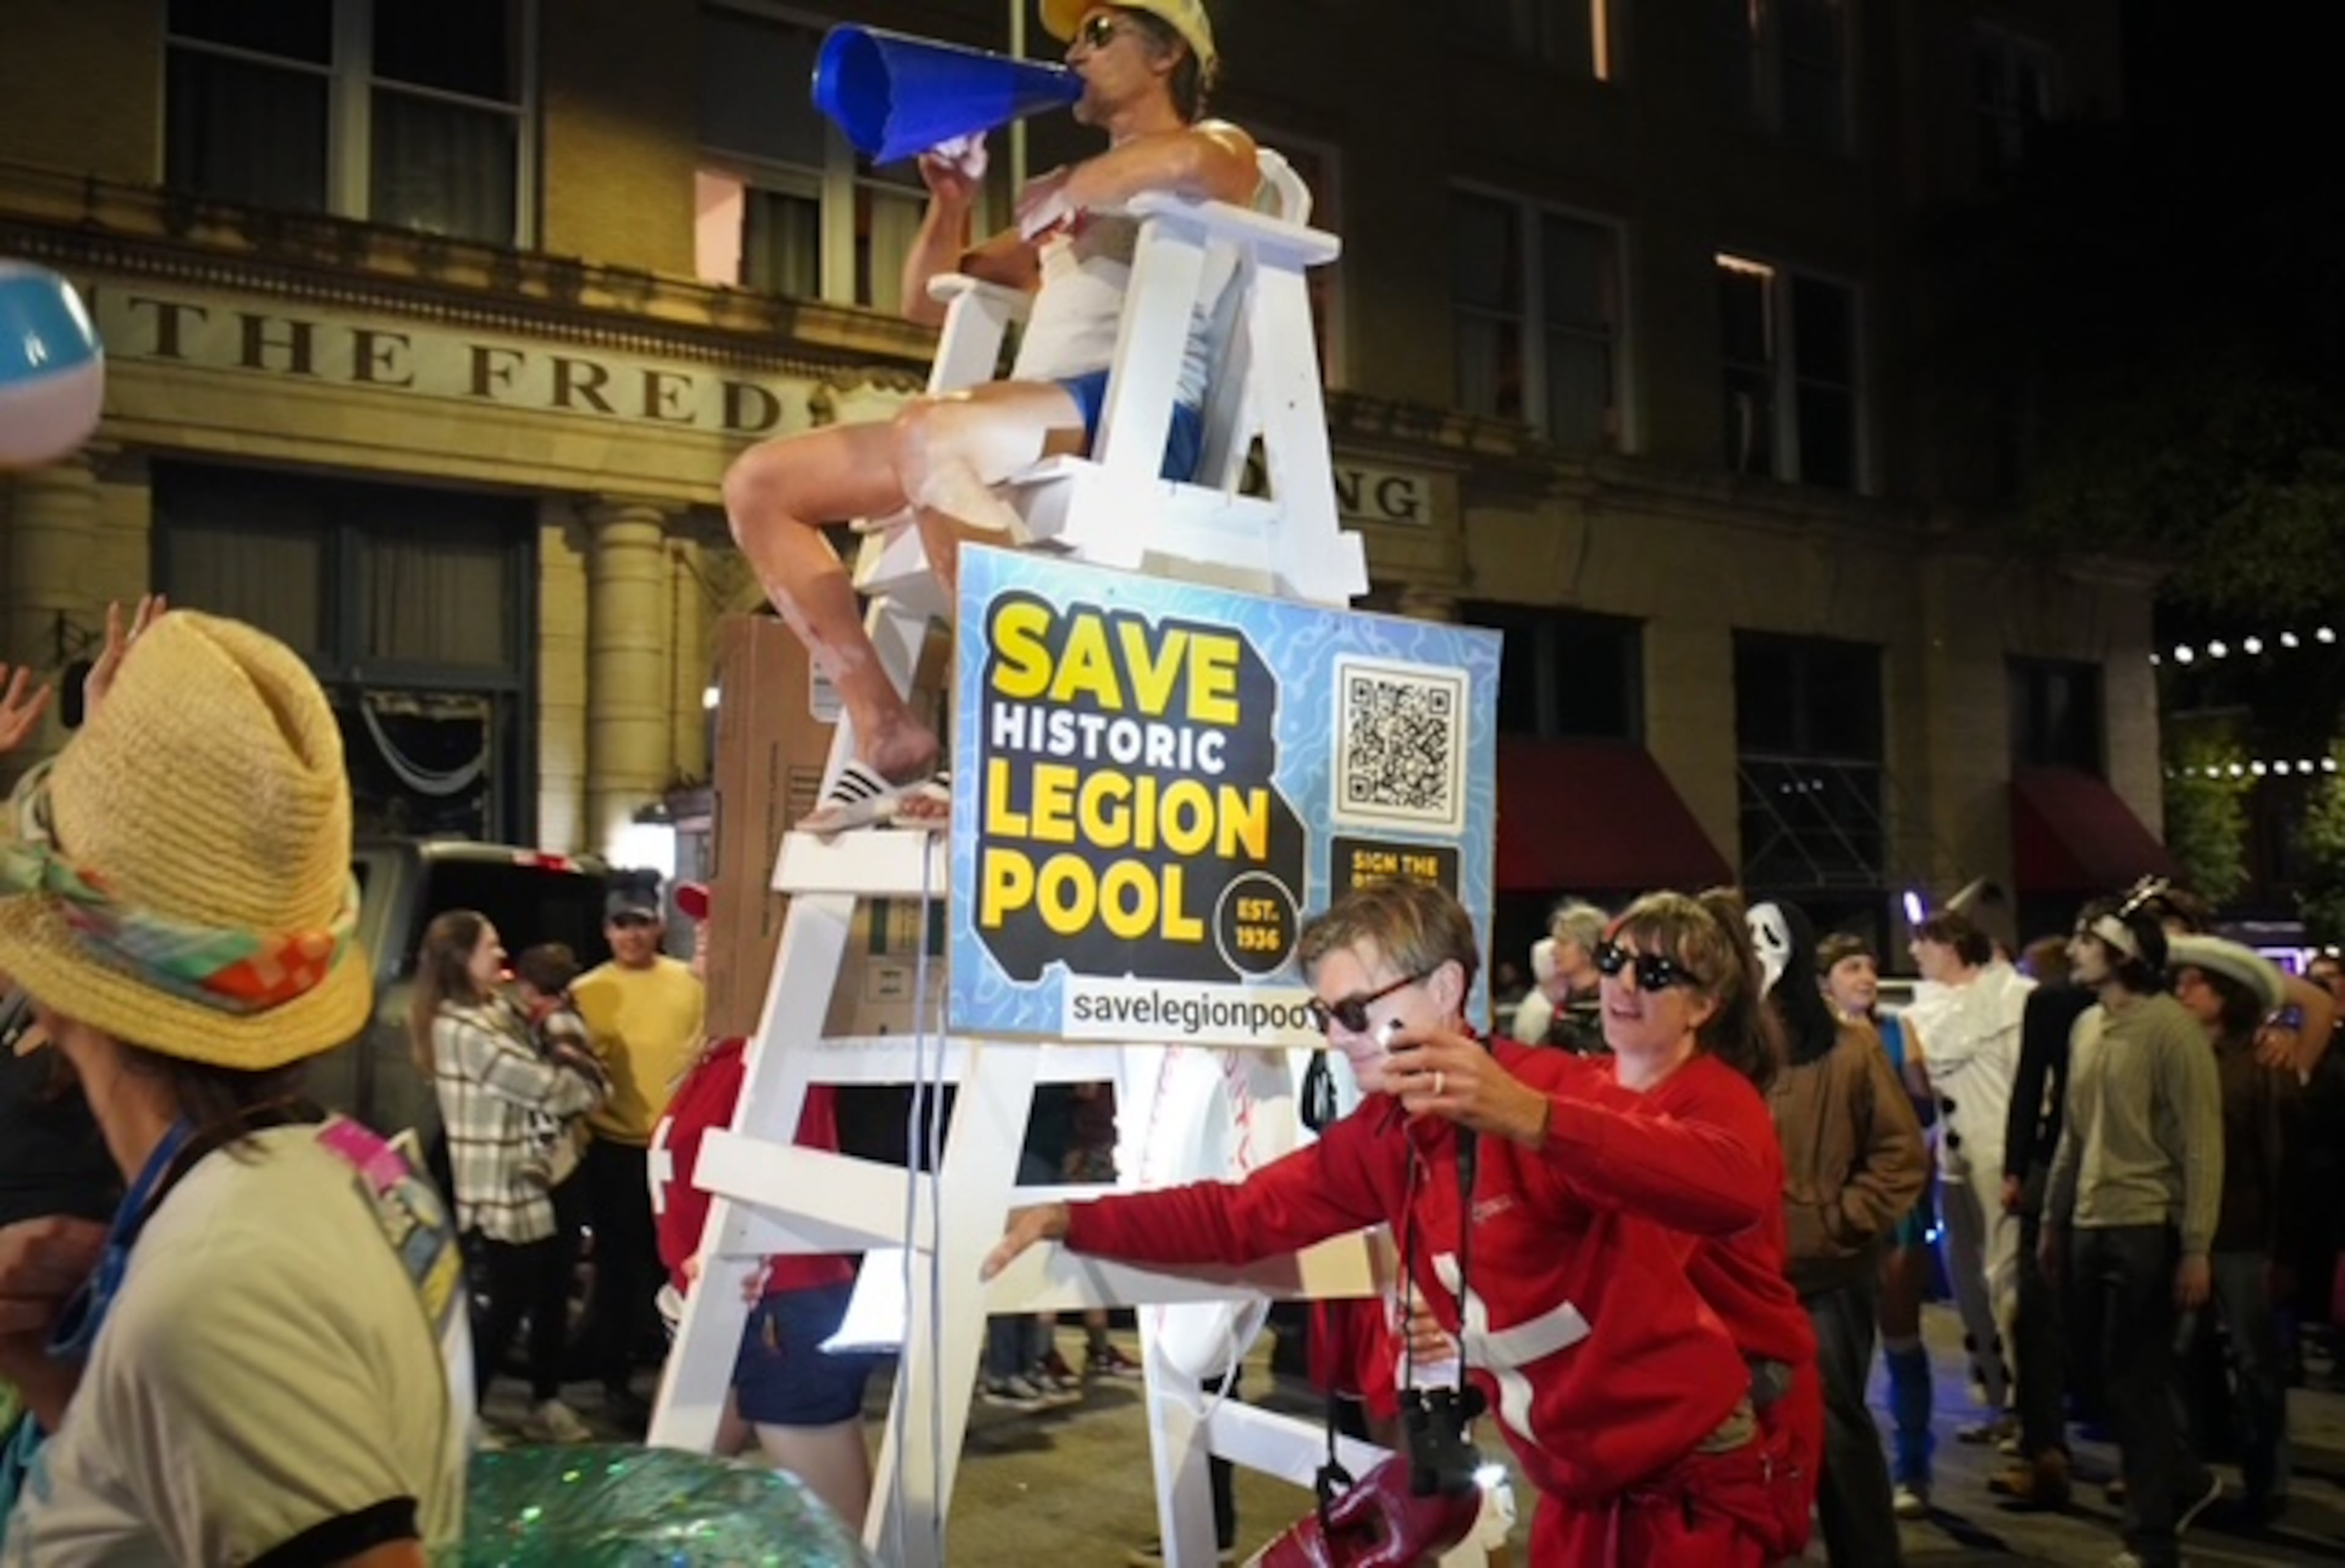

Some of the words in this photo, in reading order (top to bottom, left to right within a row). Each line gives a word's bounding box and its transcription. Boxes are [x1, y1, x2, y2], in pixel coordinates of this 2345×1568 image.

[128, 296, 415, 387] THE
[464, 343, 781, 432] FRED
[991, 600, 1240, 726] SAVE
[991, 701, 1226, 774] HISTORIC
[986, 757, 1269, 860] LEGION
[981, 847, 1204, 942] POOL
[1353, 849, 1398, 873] SIGN
[1401, 855, 1438, 877] THE
[1235, 925, 1281, 951] 1936
[1237, 897, 1280, 921] EST.
[1072, 991, 1313, 1034] savelegionpoo
